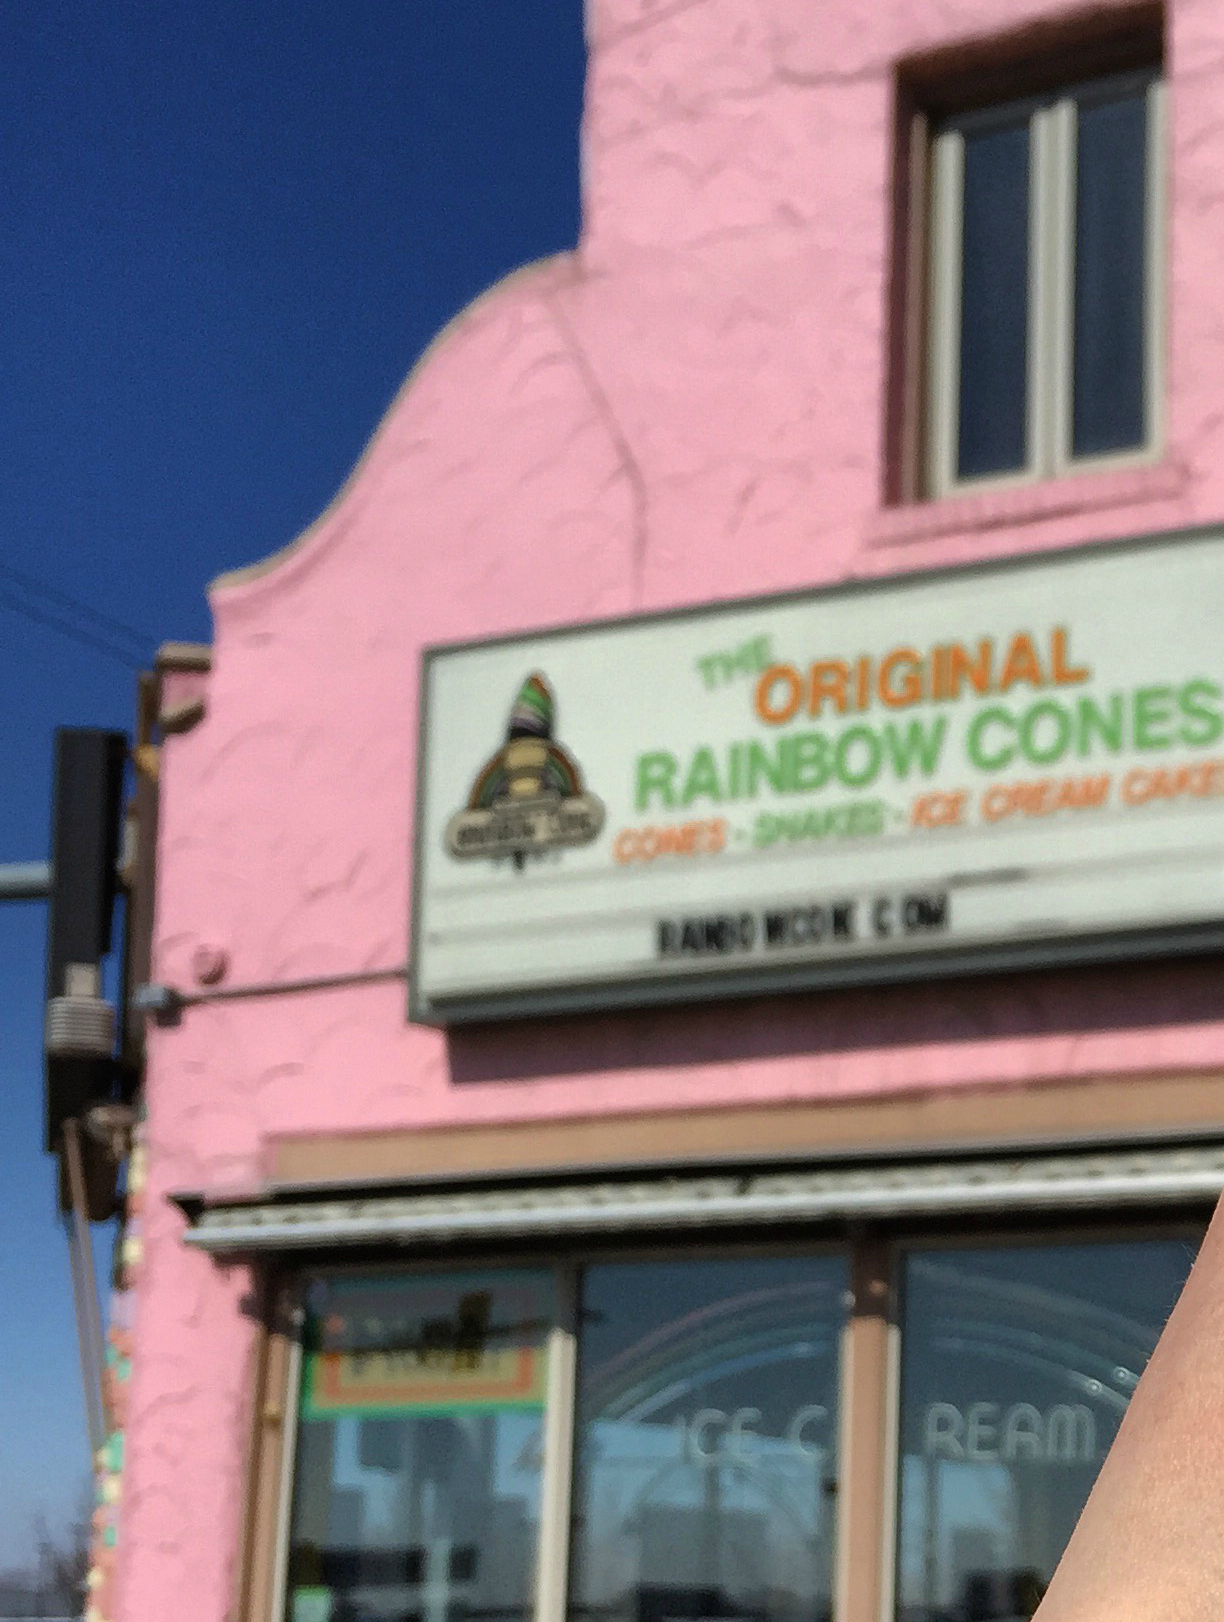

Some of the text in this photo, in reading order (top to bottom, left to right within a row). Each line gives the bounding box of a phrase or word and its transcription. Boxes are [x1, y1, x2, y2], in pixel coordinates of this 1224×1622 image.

[698, 634, 772, 689] THE
[755, 628, 1091, 726] ORIGINAL
[634, 679, 1223, 813] RAINBOW CONES
[613, 816, 727, 864] CONES
[910, 788, 967, 829] ICE
[980, 771, 1111, 822] CREAM
[679, 1406, 763, 1461] ICE
